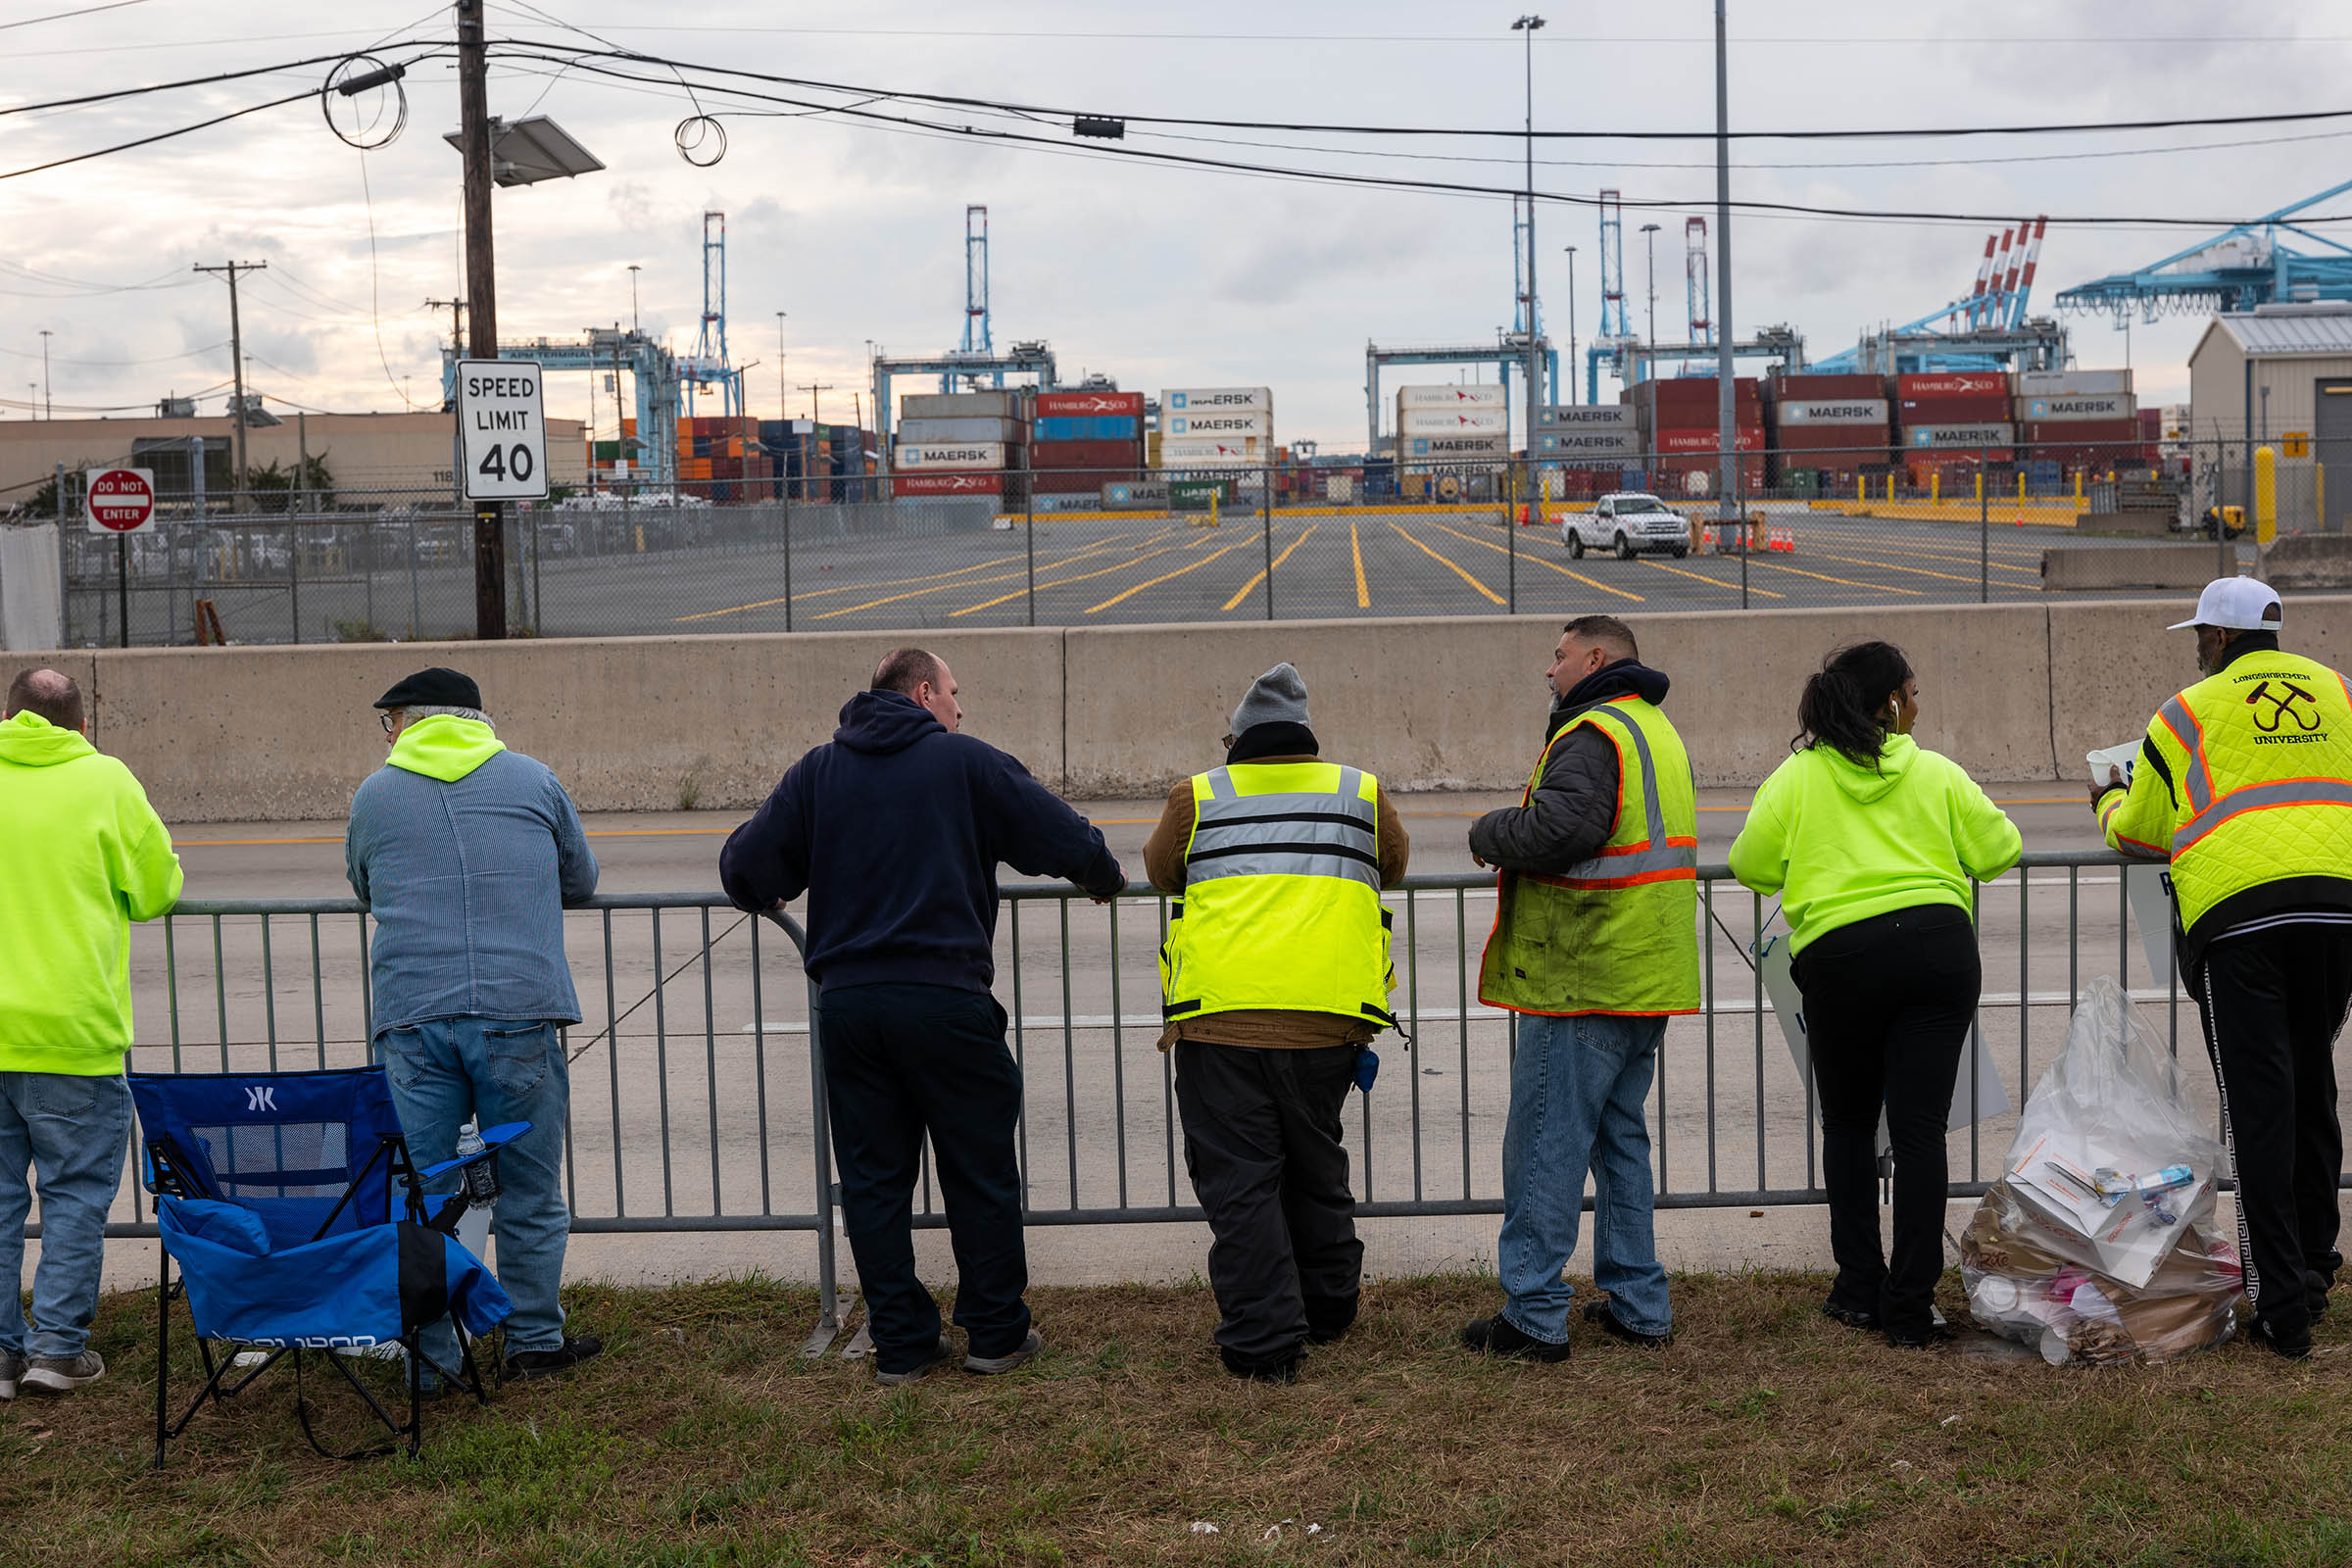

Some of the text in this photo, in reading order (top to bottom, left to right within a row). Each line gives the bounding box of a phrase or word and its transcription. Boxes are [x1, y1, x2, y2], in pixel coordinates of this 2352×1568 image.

[468, 377, 534, 398] SPEED
[1912, 381, 1958, 391] HAMBURG
[1049, 401, 1093, 410] HAMBURG
[2051, 400, 2116, 413] MAERSK
[1558, 412, 1623, 422] MAERSK
[1809, 407, 1874, 417] MAERSK
[477, 411, 528, 430] LIMIT
[1191, 419, 1253, 429] MAERSK
[1432, 440, 1494, 451] MAERSK
[1560, 437, 1624, 447] MAERSK
[924, 451, 988, 461] MAERSK
[479, 444, 533, 482] 40
[432, 470, 453, 482] 118
[98, 481, 143, 492] DO NOT
[1132, 489, 1166, 499] MAE
[103, 509, 139, 520] ENTER
[2232, 672, 2312, 684] LONGSHOREMEN
[2253, 734, 2328, 745] UNIVERSITY
